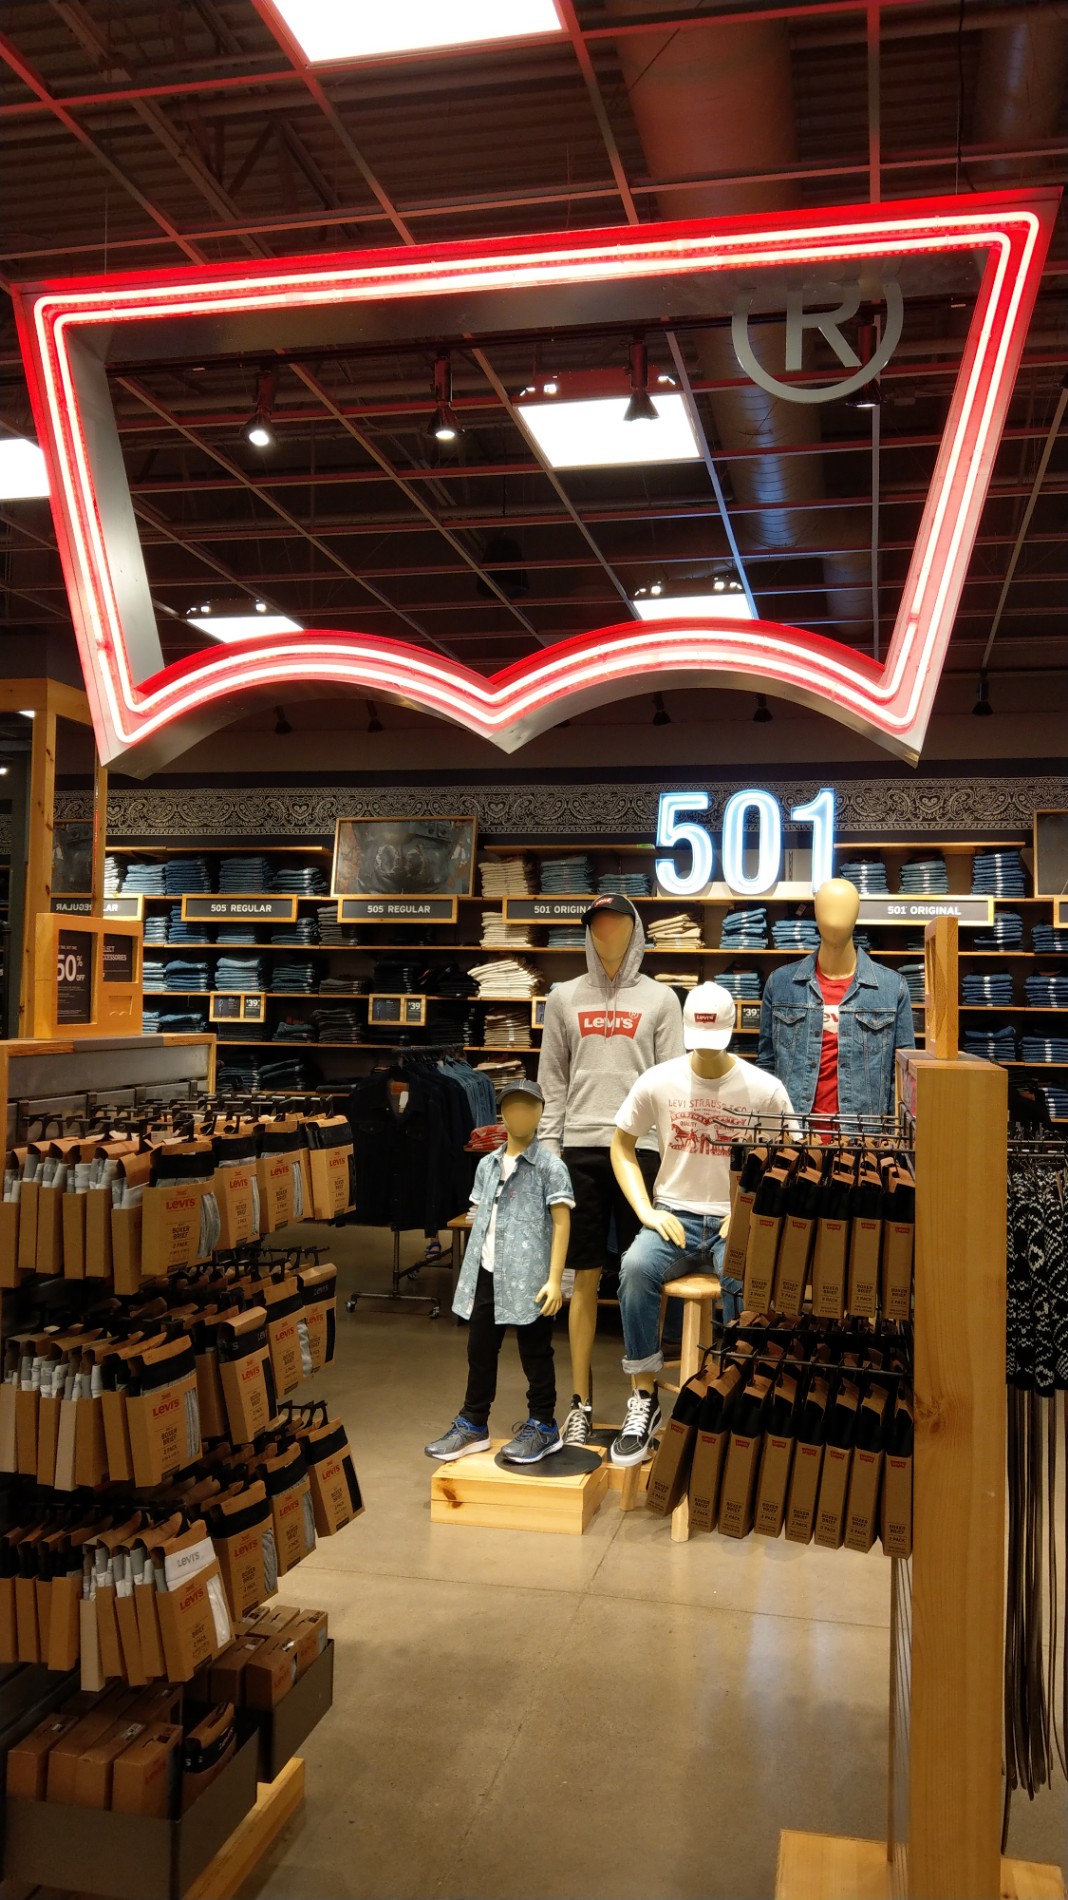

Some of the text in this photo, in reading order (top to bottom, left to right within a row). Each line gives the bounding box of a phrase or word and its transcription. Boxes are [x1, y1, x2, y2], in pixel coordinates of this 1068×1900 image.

[655, 787, 835, 895] 501
[230, 904, 272, 913] REGULAR
[388, 905, 431, 914] REGULAR
[554, 905, 591, 914] ORIGIN
[910, 906, 962, 916] ORIGINAL
